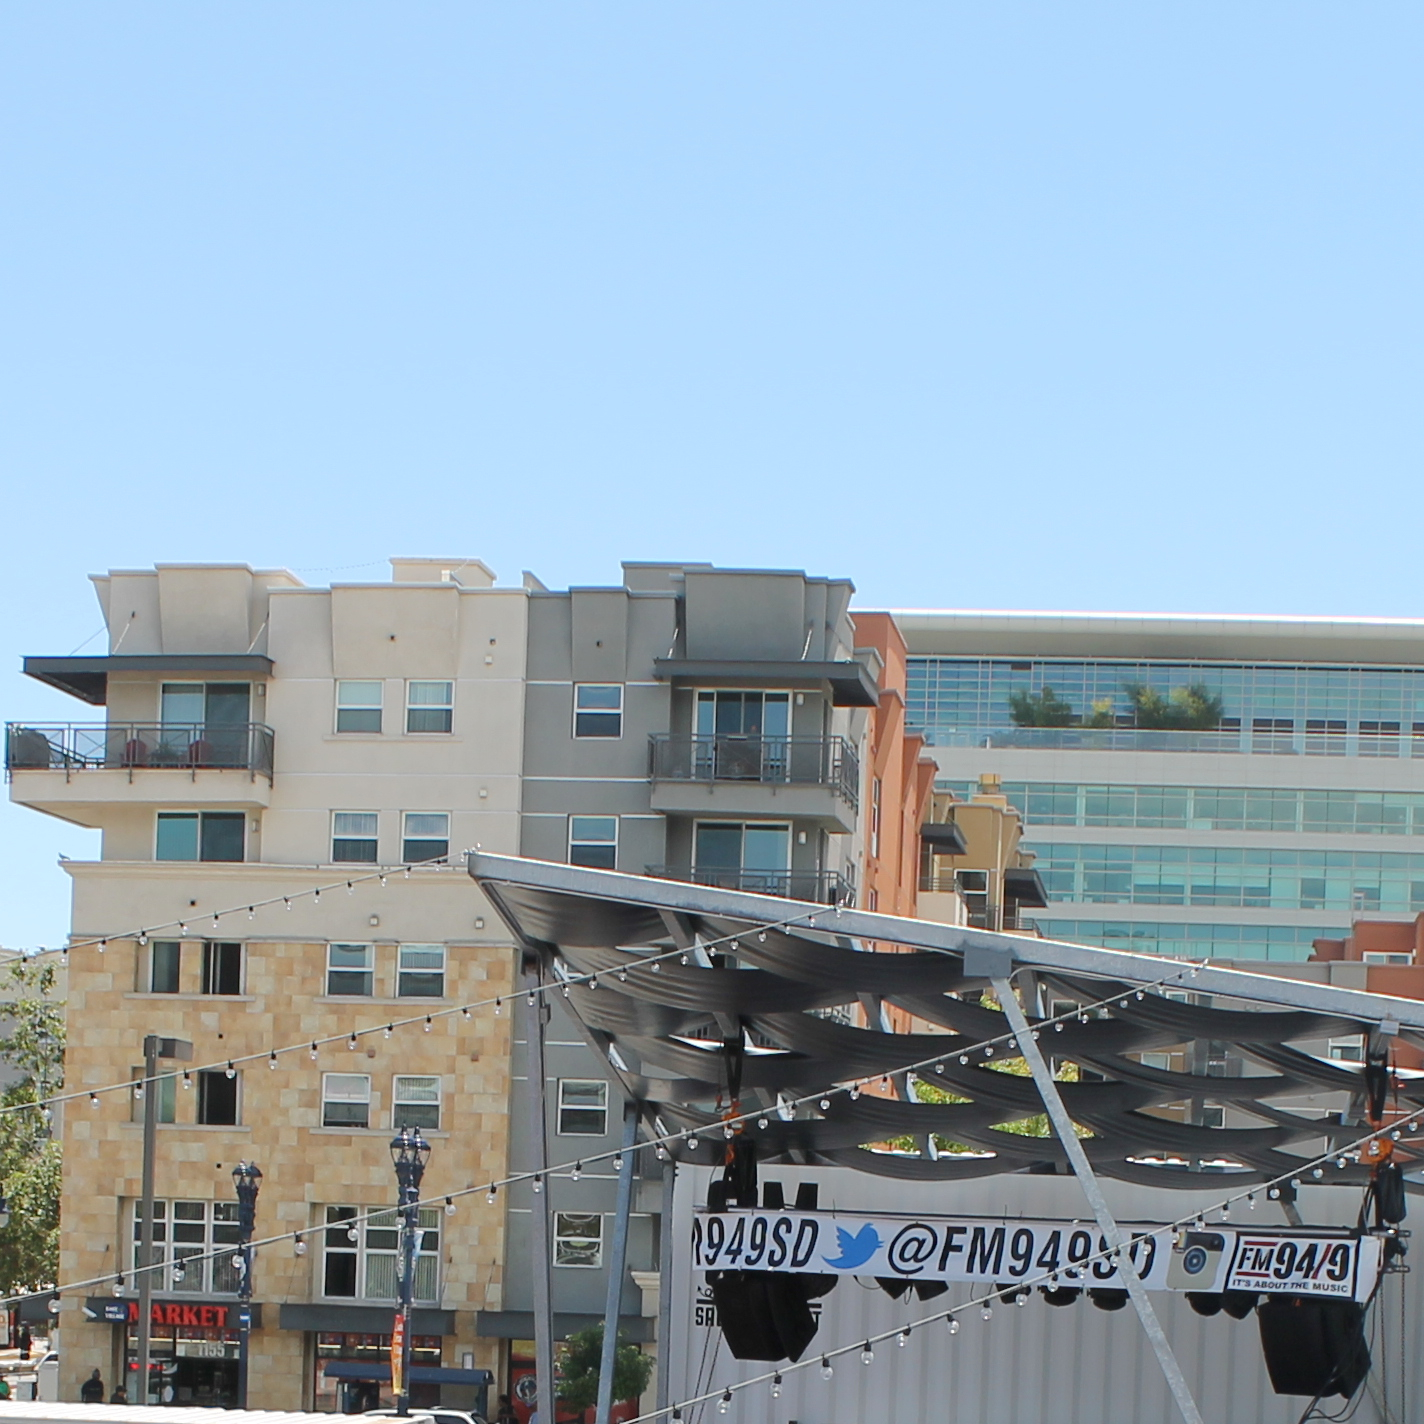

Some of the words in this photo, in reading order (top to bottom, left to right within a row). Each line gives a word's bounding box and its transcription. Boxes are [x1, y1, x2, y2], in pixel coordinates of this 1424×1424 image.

[1254, 1281, 1288, 1290] ABOUT
[1290, 1282, 1309, 1290] THE
[1312, 1283, 1349, 1293] MUSIC
[128, 1302, 229, 1328] MARKET
[198, 1344, 226, 1357] 1155
